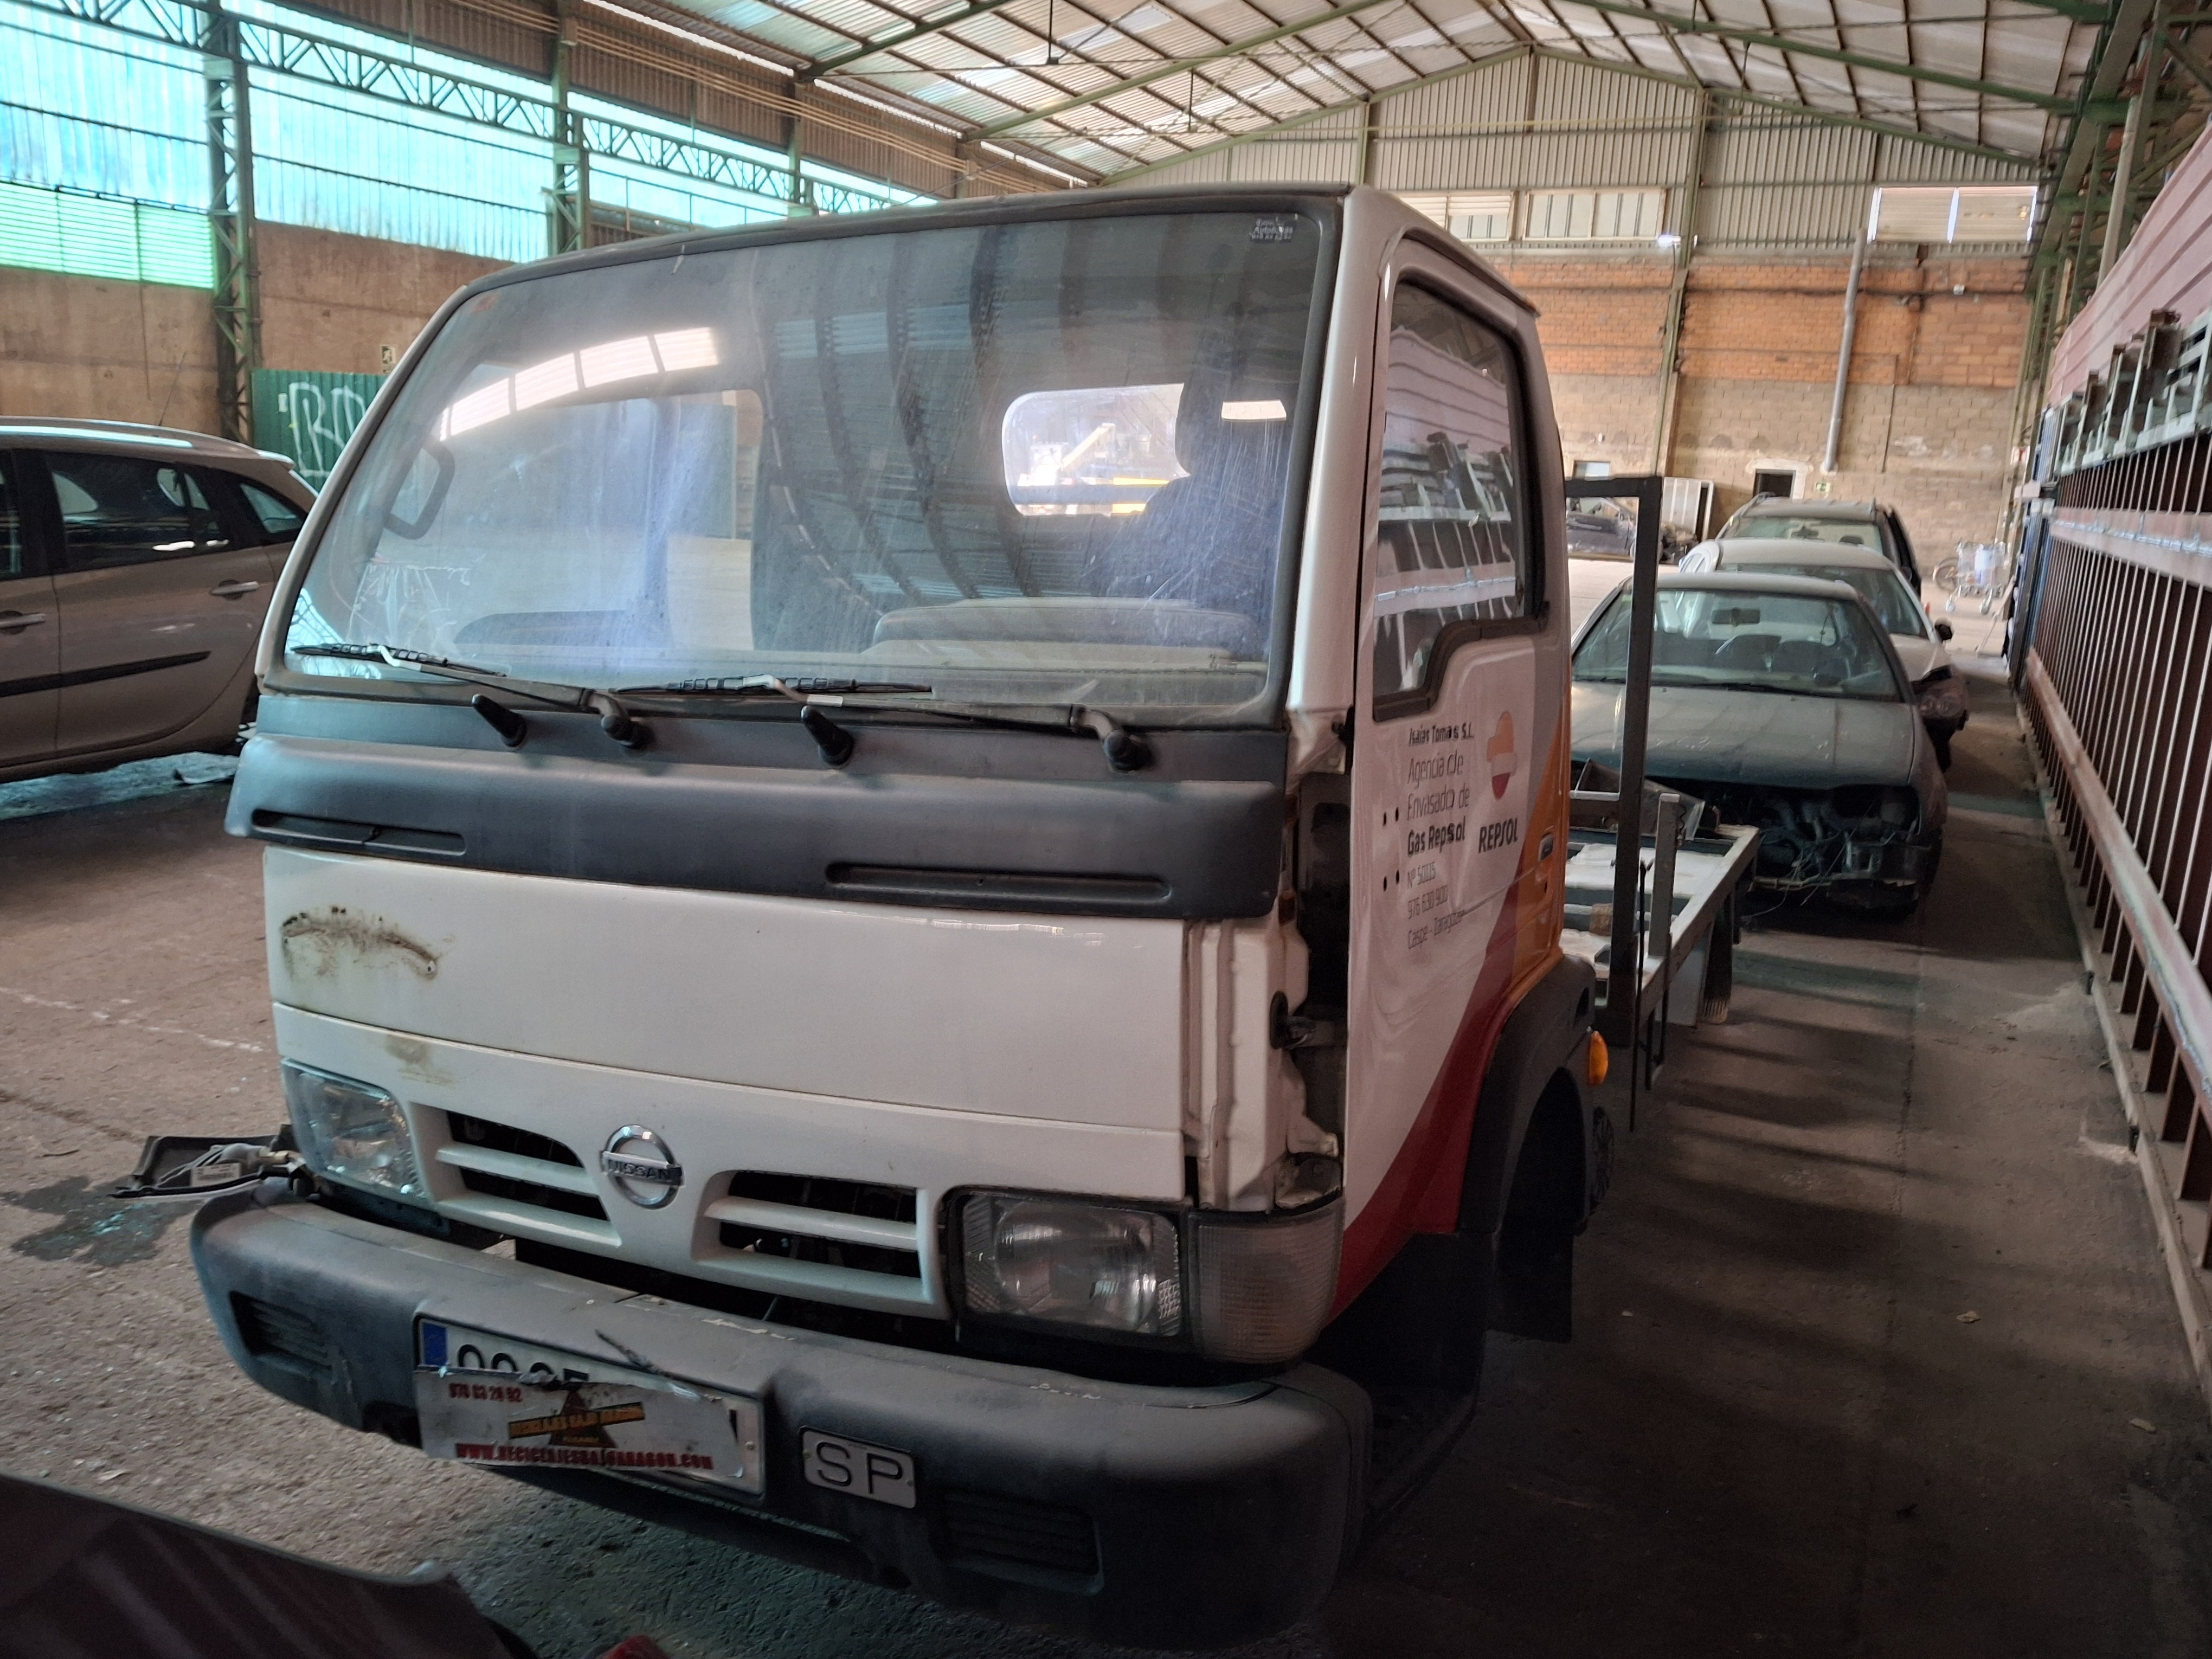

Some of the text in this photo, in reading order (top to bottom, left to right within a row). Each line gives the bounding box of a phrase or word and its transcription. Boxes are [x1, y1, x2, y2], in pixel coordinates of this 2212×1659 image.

[1407, 749, 1464, 790] Agencia de
[1407, 783, 1470, 821] Envasado de
[1408, 815, 1466, 858] Gas Repsol
[1478, 818, 1518, 854] REPSOL
[607, 1159, 671, 1181] NISSAN
[816, 1441, 903, 1495] SP
